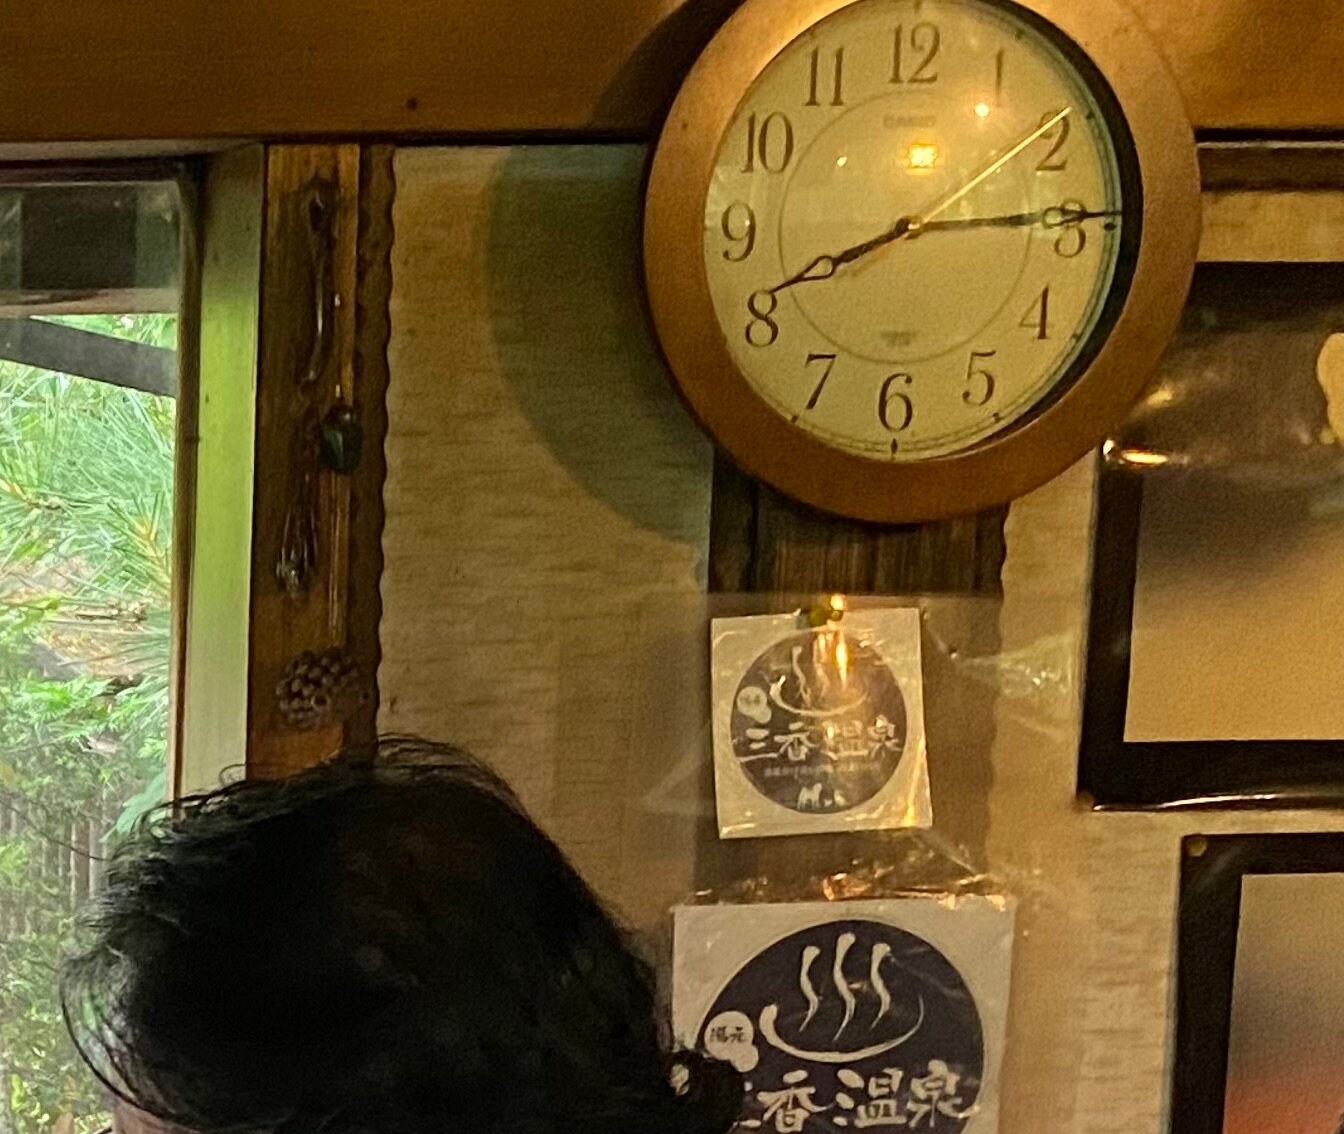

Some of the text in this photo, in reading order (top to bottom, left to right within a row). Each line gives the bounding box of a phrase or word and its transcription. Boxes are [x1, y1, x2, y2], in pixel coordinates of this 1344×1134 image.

[804, 46, 846, 108] 11
[887, 22, 941, 85] 12
[993, 47, 1008, 108] 1
[741, 111, 795, 175] 10
[1035, 109, 1071, 173] 2
[720, 202, 758, 263] 9
[1053, 200, 1088, 259] 3
[744, 290, 779, 348] 8
[1018, 286, 1052, 341] 4
[803, 352, 837, 411] 7
[877, 373, 913, 433] 6
[961, 350, 997, 407] 5
